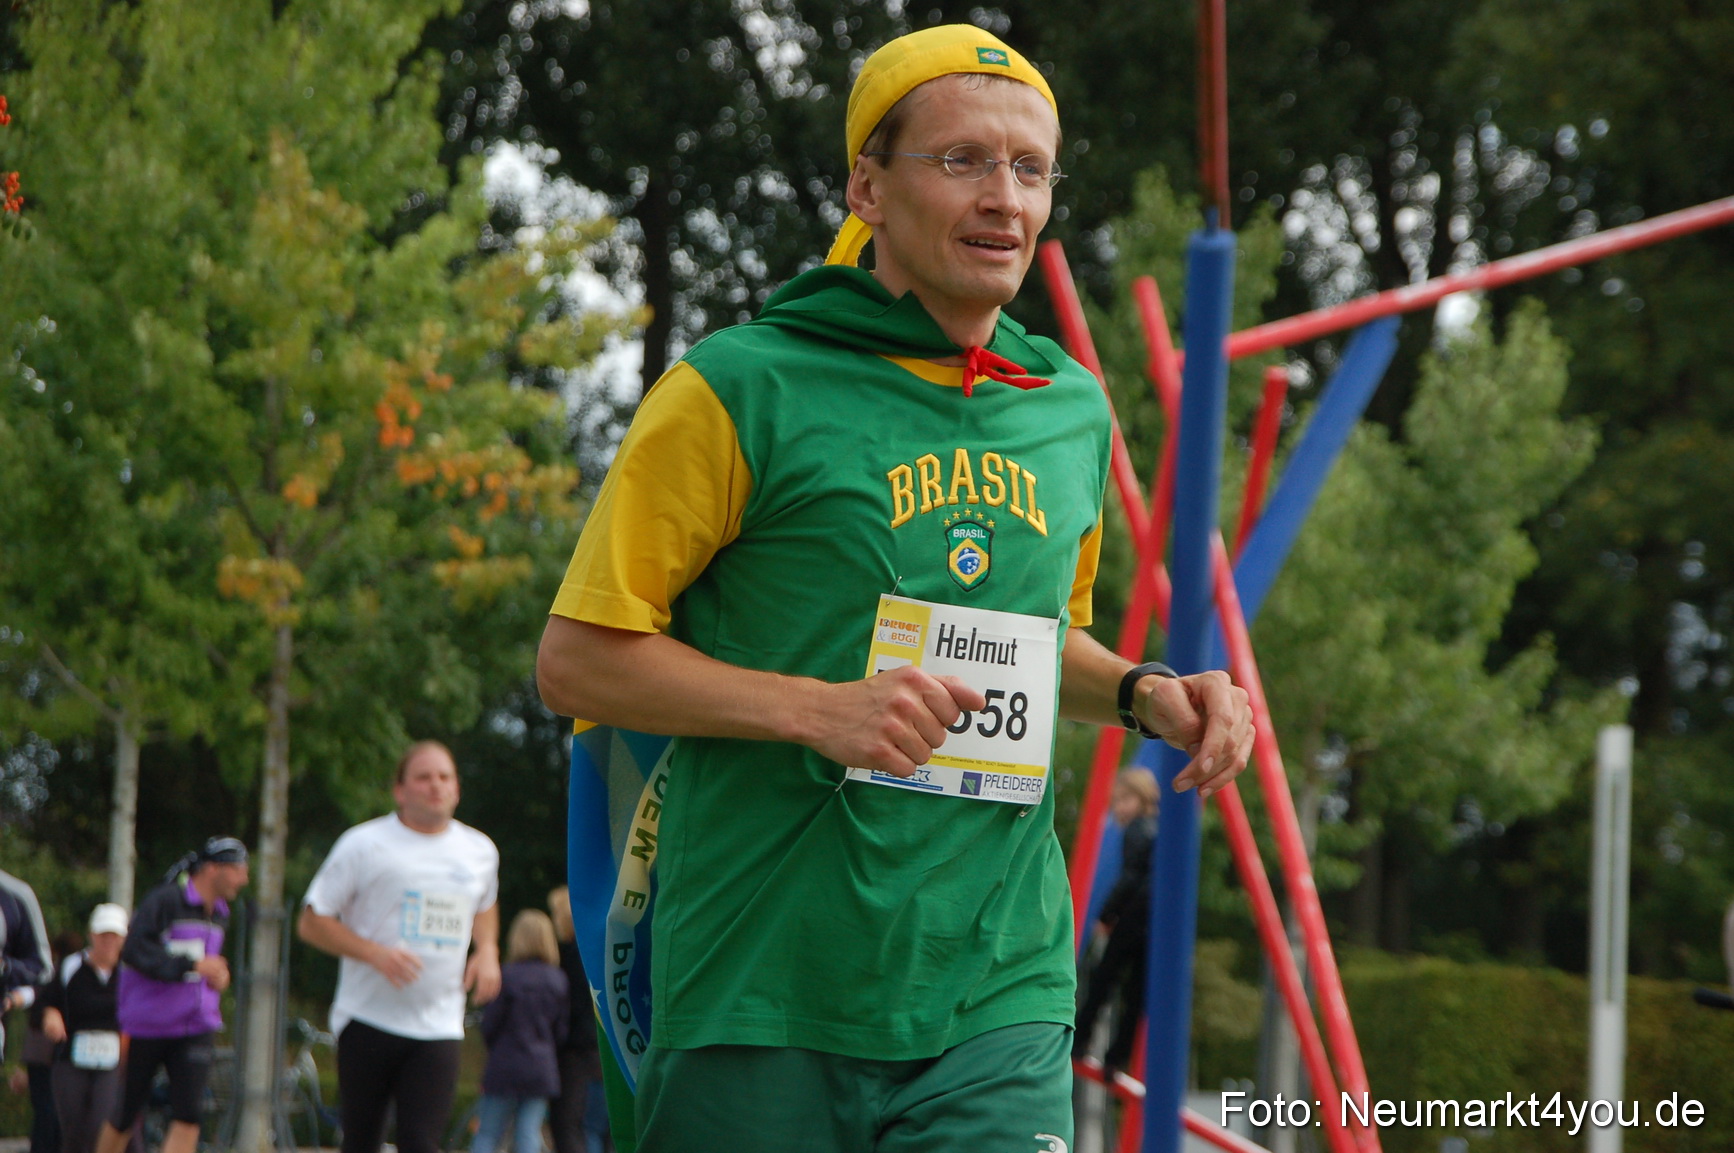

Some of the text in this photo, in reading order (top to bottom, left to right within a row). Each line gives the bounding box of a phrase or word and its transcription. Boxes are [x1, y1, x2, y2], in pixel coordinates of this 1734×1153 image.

[887, 448, 1048, 537] BRASIL
[953, 528, 986, 539] BRASIL
[935, 623, 1018, 667] Helmut
[983, 774, 1043, 793] PFLEIDERER
